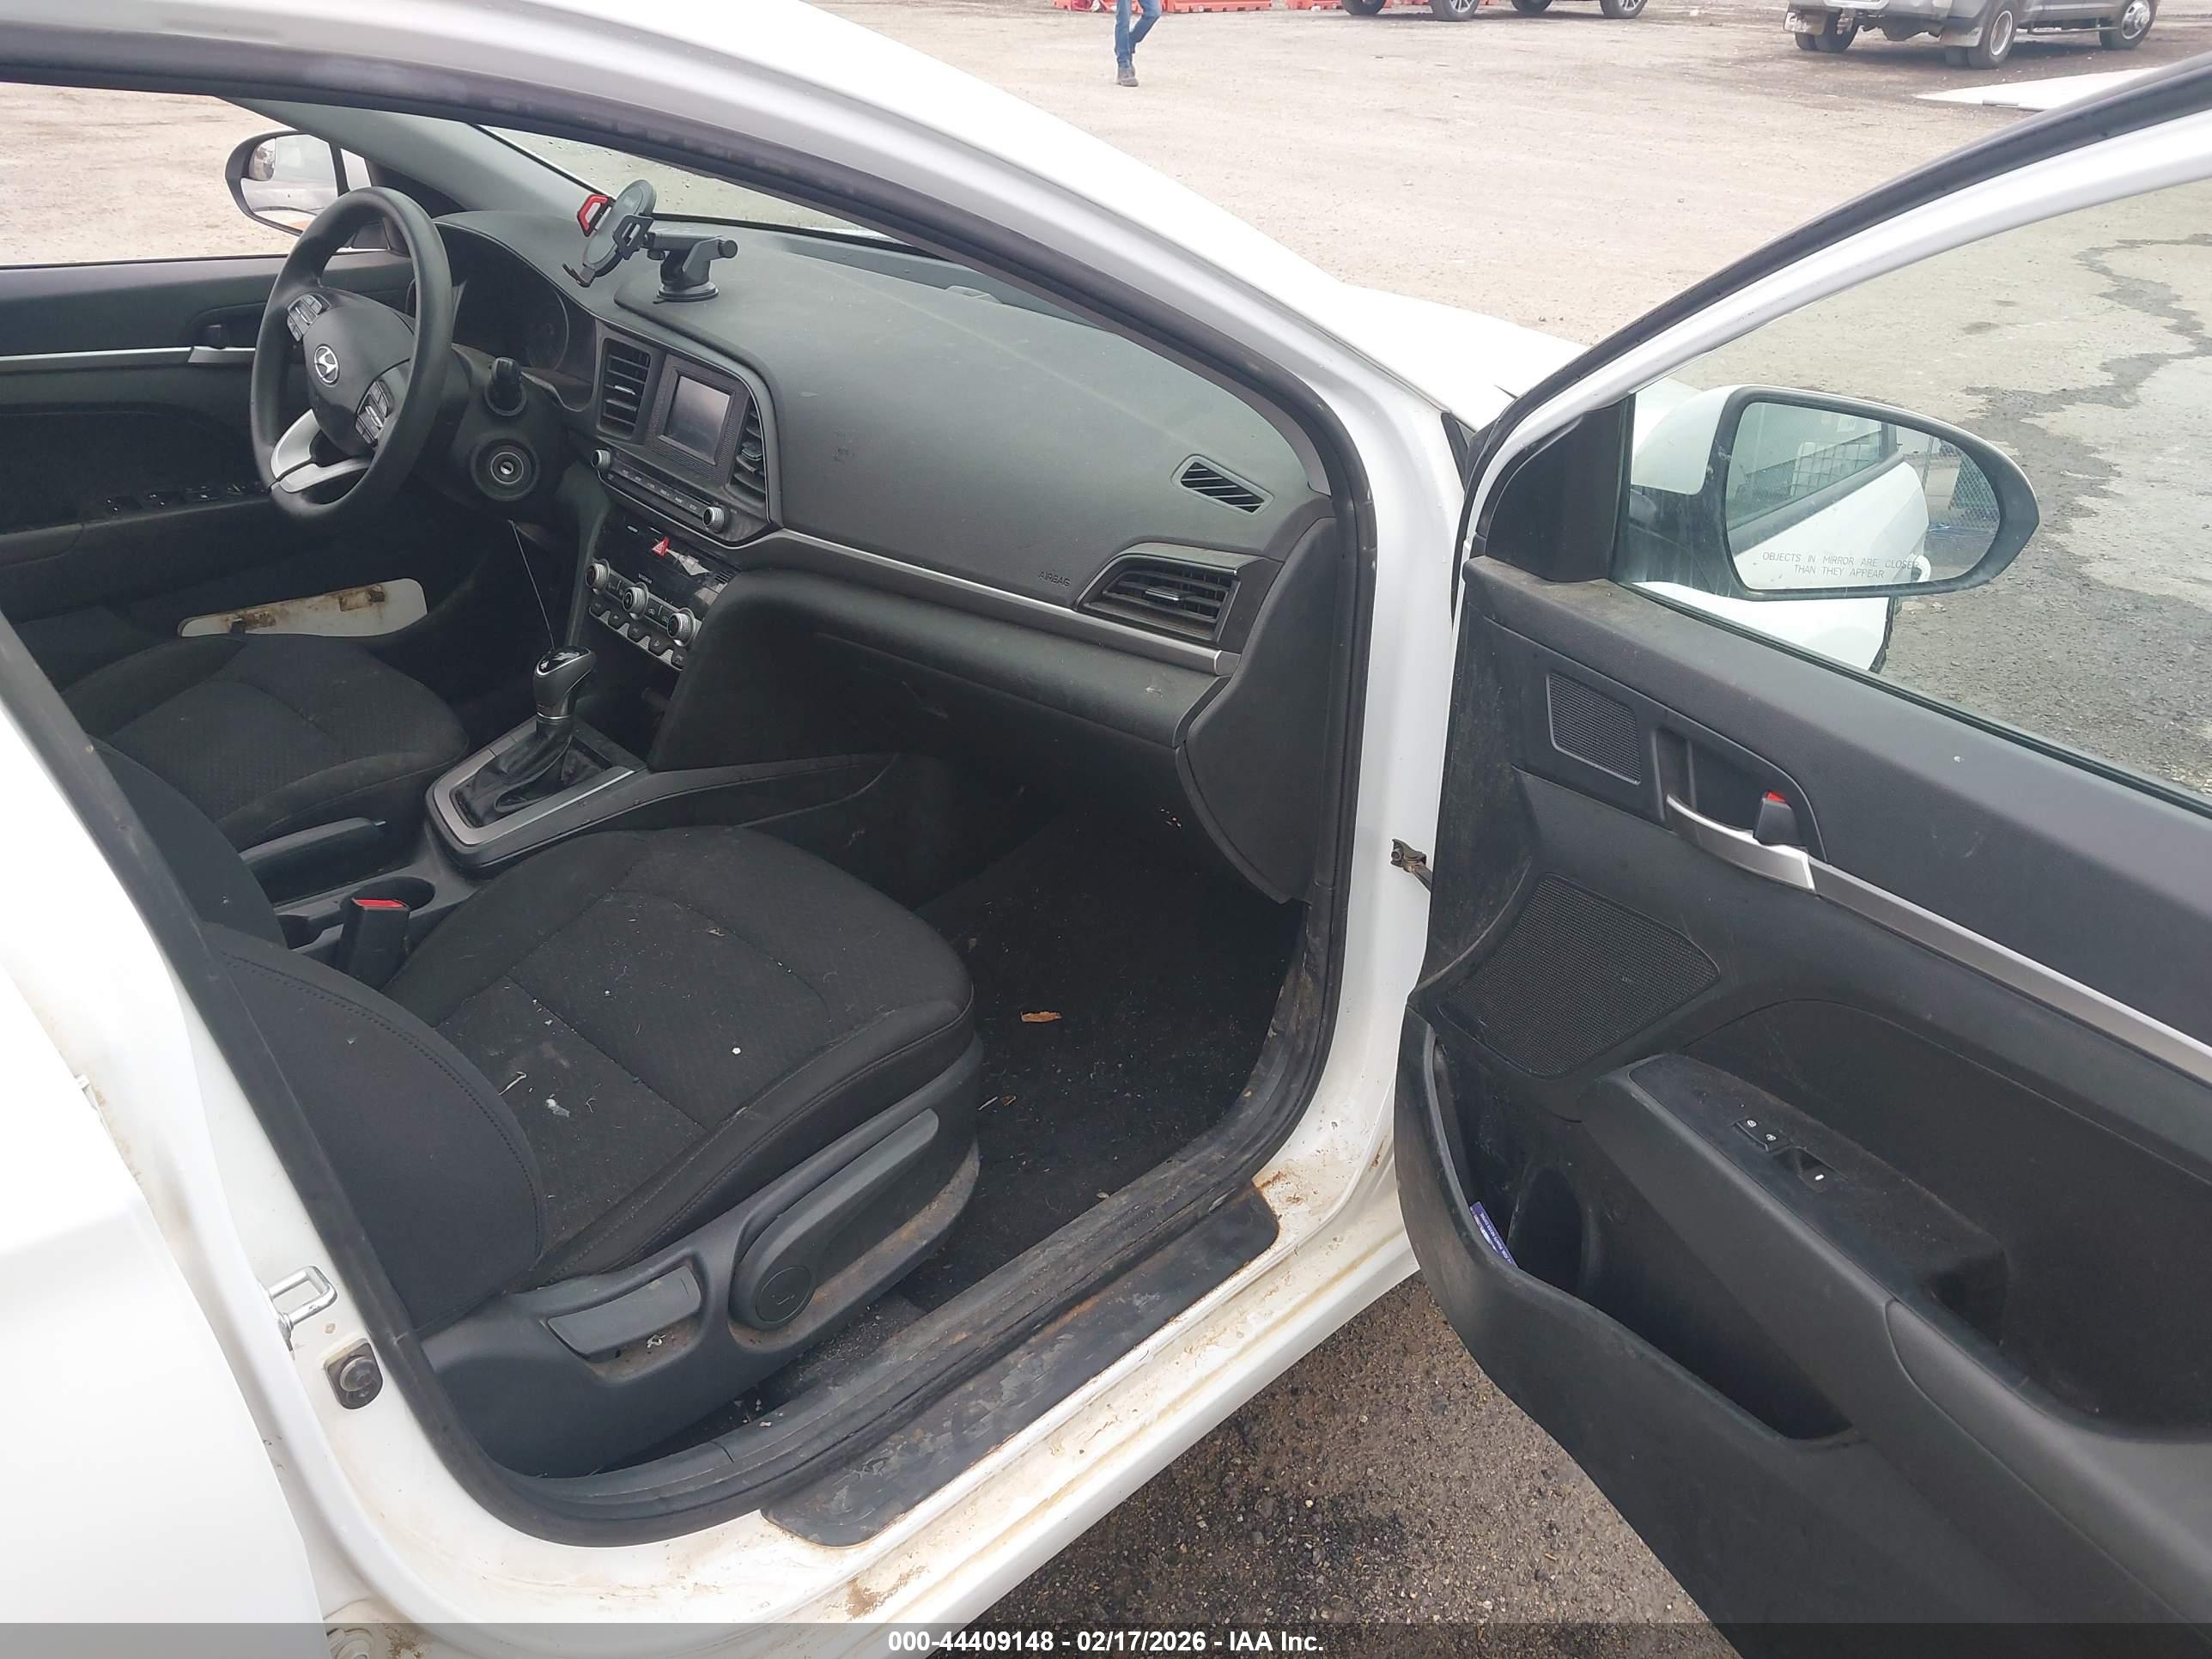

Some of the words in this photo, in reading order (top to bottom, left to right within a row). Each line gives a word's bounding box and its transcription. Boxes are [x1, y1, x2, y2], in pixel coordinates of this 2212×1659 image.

[1762, 551, 1801, 562] OBJECTS
[1808, 554, 1816, 563] IN
[1822, 555, 1855, 566] MIRROR
[1861, 556, 1878, 567] ARE
[1037, 570, 1072, 586] AIRBAG
[1794, 564, 1816, 574] THAN
[1822, 566, 1844, 576] THEY
[1849, 568, 1885, 578] APPEAR
